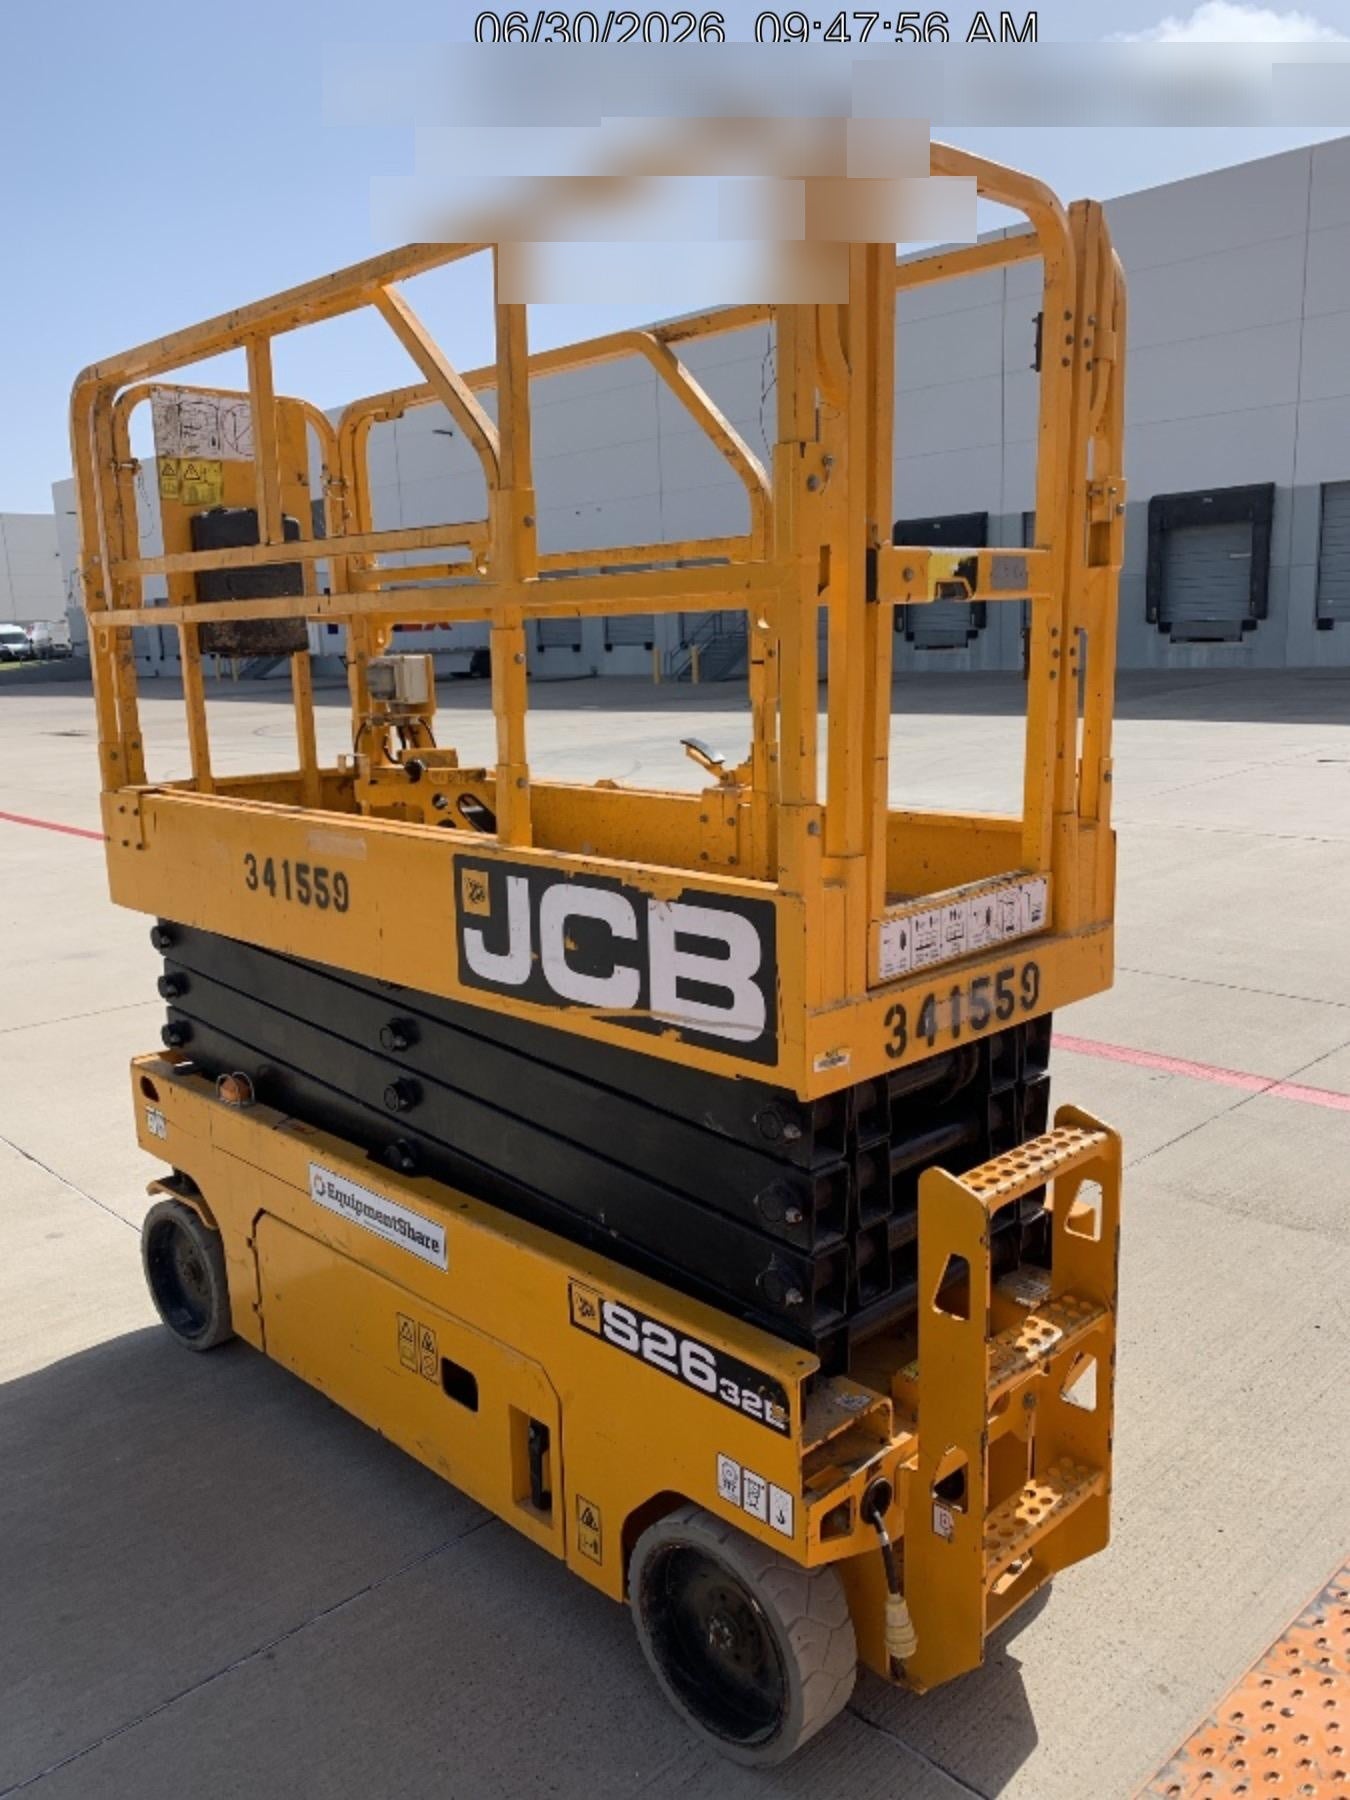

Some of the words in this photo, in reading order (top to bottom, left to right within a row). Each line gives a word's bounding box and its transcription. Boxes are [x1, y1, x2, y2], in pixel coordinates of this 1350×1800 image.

[244, 853, 350, 913] 341559
[463, 875, 767, 1042] JCB
[884, 961, 1041, 1059] 341559
[327, 1180, 441, 1254] EquipmentShare
